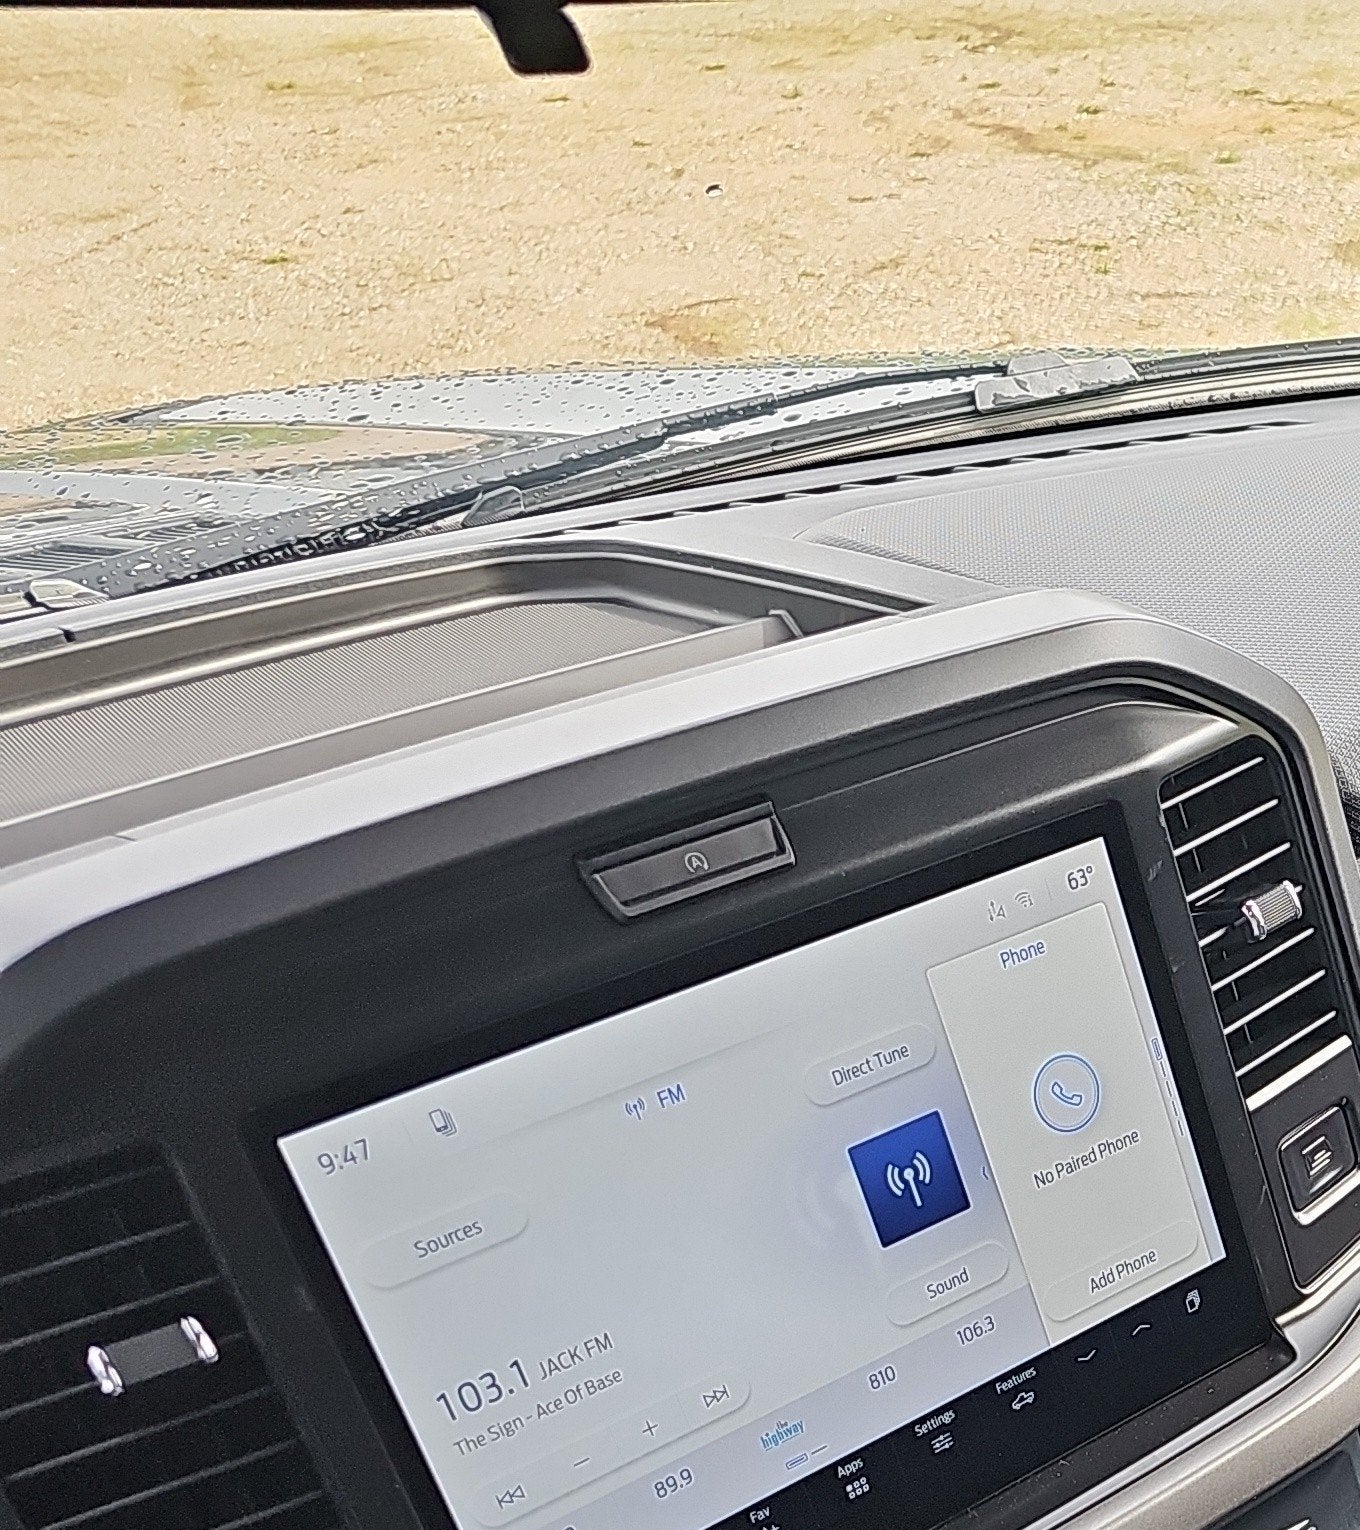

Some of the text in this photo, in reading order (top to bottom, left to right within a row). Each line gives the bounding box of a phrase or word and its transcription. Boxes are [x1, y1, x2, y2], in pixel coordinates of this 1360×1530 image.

[1000, 940, 1046, 969] Phone
[831, 1044, 910, 1087] Direct Tune
[657, 1084, 687, 1109] FM
[317, 1138, 370, 1175] 9:47
[1033, 1130, 1140, 1189] No Paired Phone
[413, 1220, 483, 1258] Sources
[926, 1267, 970, 1300] Sound
[1089, 1249, 1157, 1294] Add Phone
[956, 1315, 996, 1346] 106.3
[435, 1332, 614, 1422] 103.1 JACK FM
[869, 1365, 897, 1390] 810
[995, 1366, 1037, 1394] Features
[453, 1435, 487, 1457] The
[488, 1412, 525, 1443] Sign
[535, 1396, 564, 1420] Ace
[564, 1383, 584, 1406] Of
[585, 1369, 624, 1396] Base
[914, 1408, 956, 1437] Settings
[760, 1420, 804, 1449] highway
[654, 1468, 694, 1499] 89.9
[837, 1457, 864, 1479] Apps
[749, 1506, 770, 1524] Fav
